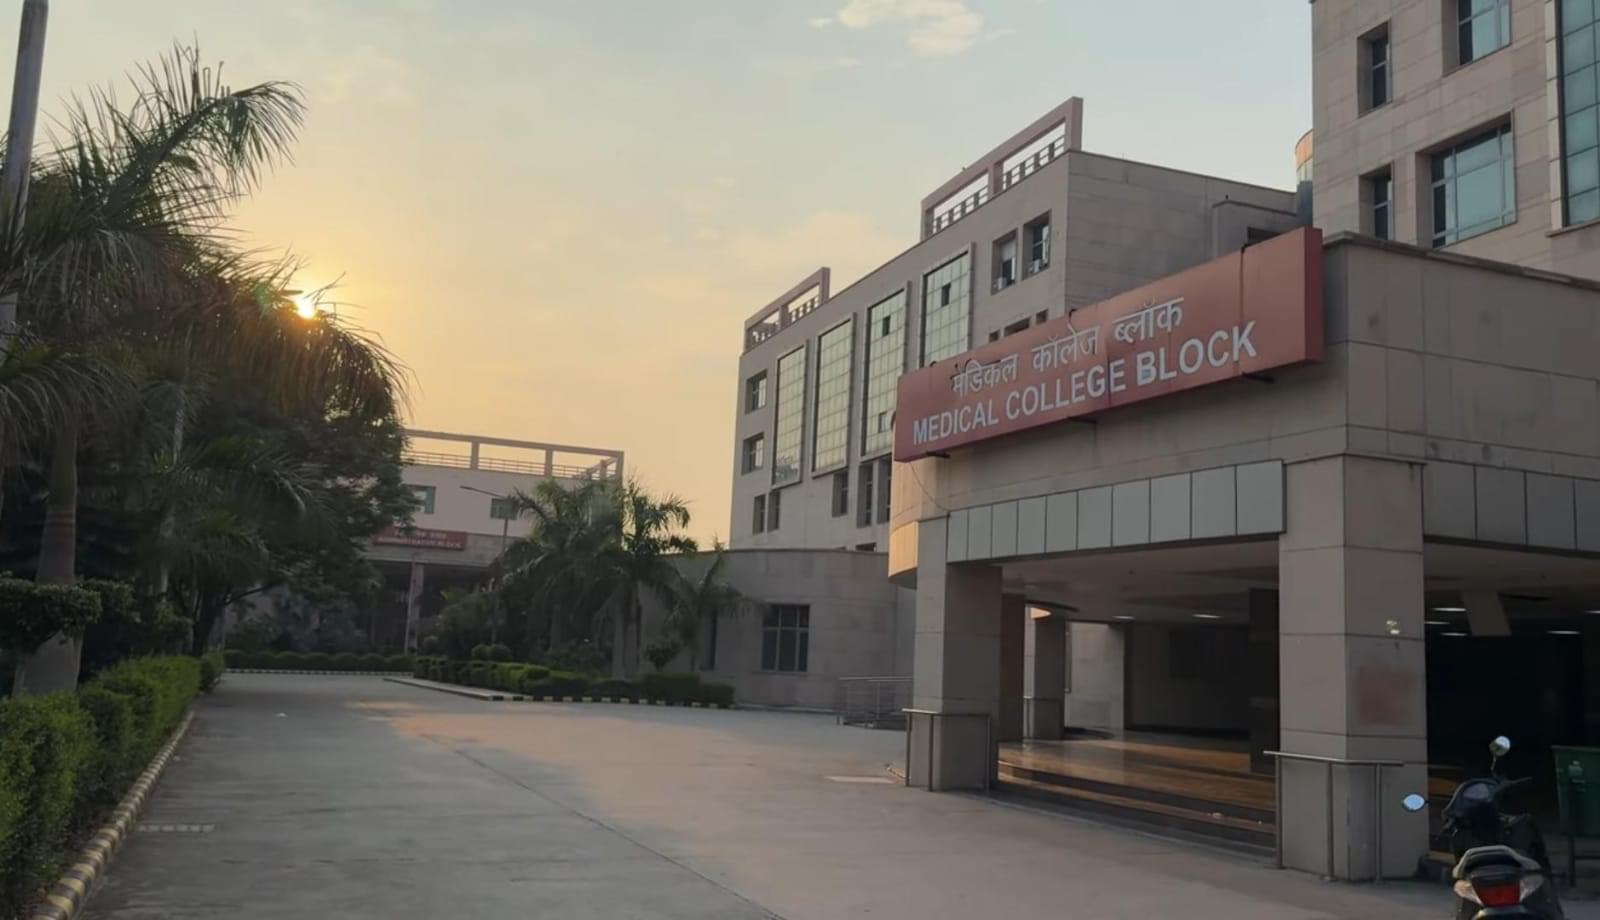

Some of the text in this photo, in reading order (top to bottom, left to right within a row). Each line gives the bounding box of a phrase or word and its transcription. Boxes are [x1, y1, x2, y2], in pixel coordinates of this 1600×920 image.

[912, 320, 1257, 445] MEDICAL COLLEGE BLOCK
[951, 297, 1185, 397] मेडिकल कॉलेज ब्लॉक
